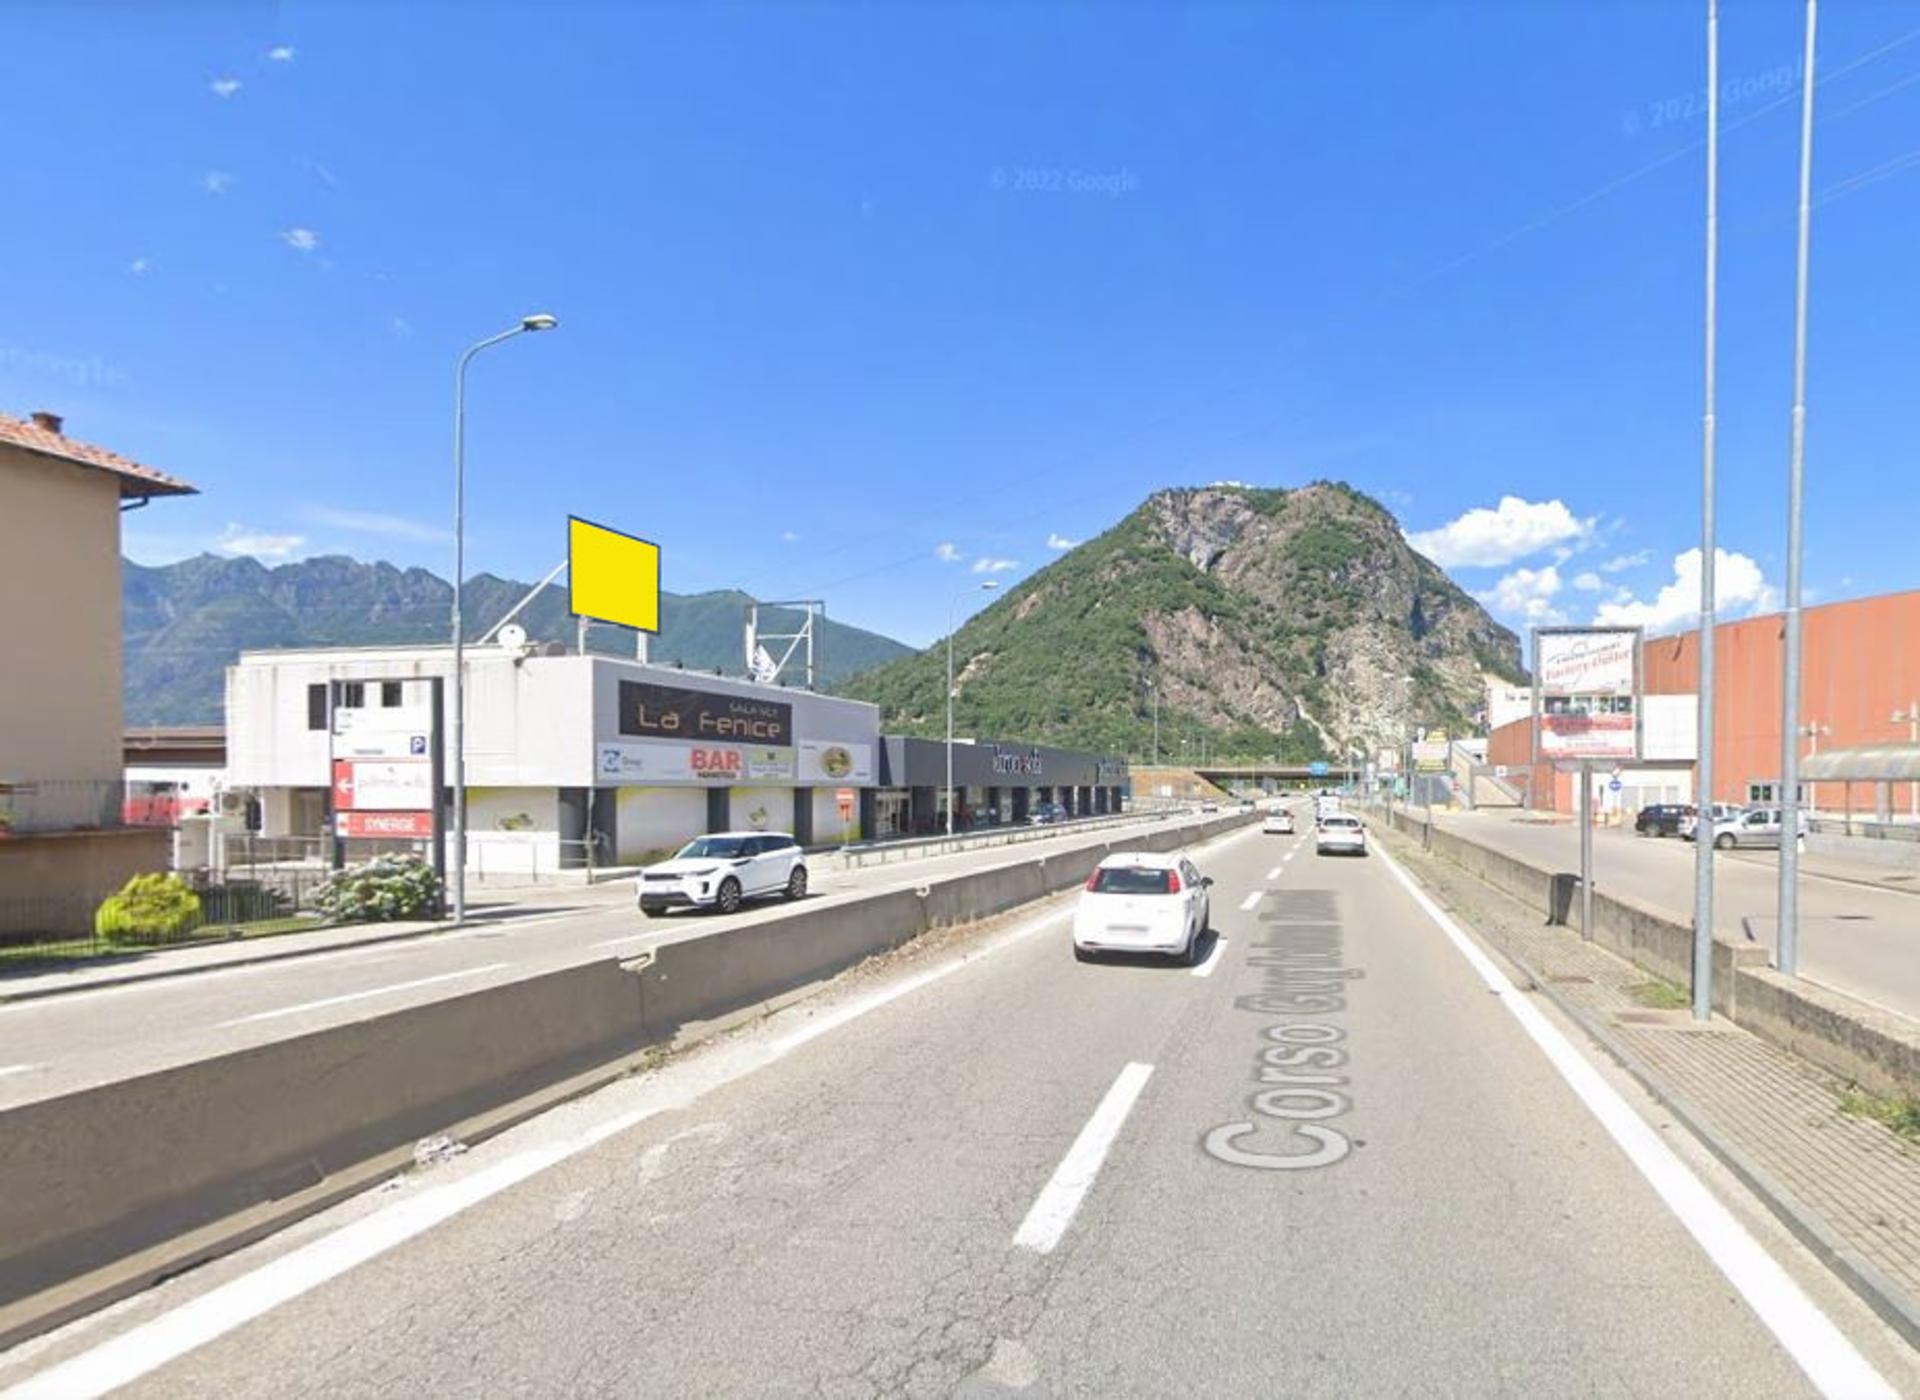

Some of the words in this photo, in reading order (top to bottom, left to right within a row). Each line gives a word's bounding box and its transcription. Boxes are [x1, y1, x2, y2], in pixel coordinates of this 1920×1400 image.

[638, 703, 680, 730] La
[699, 711, 781, 738] Fenice
[690, 748, 741, 770] BAR
